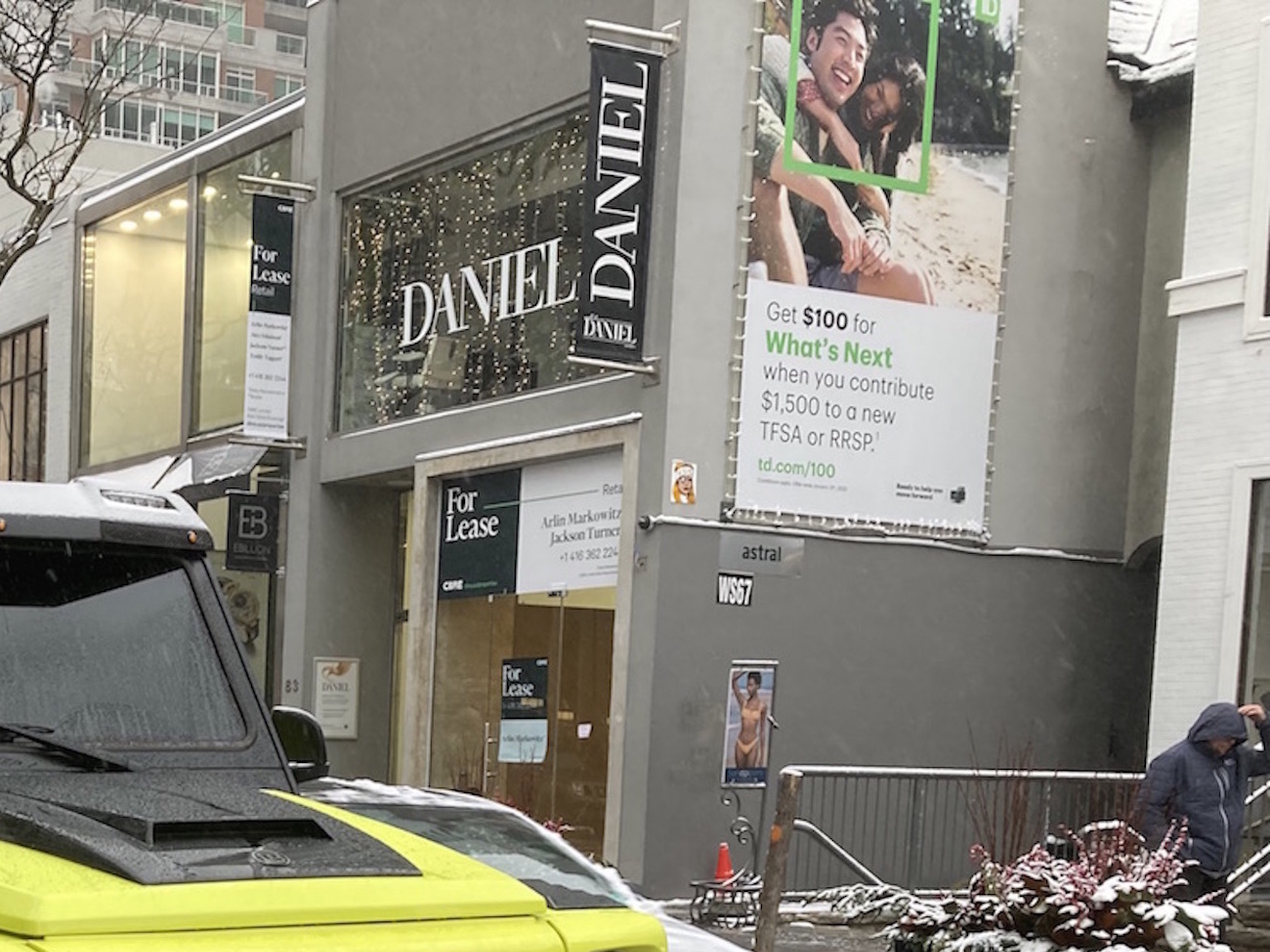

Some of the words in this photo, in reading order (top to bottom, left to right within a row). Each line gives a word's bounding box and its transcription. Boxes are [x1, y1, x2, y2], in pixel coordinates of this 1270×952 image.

[589, 61, 648, 308] DANIEL
[253, 244, 279, 263] For
[252, 264, 292, 285] Lease
[398, 237, 576, 347] DANIEL
[767, 301, 797, 324] Get
[803, 305, 849, 330] $100
[853, 313, 877, 335] for
[766, 330, 839, 361] What's
[844, 341, 893, 368] Next
[763, 362, 809, 384] when
[815, 371, 844, 390] you
[849, 377, 935, 400] contribute
[761, 389, 820, 415] $1,500
[825, 401, 841, 418] to
[846, 405, 857, 421] a
[862, 407, 896, 424] new
[760, 421, 802, 444] TFSA
[807, 431, 825, 446] or
[758, 457, 836, 479] td.com/100
[446, 487, 478, 515] For
[445, 515, 499, 542] Lease
[541, 514, 566, 529] Arlin
[550, 529, 586, 547] Jackson
[742, 544, 781, 562] astral
[718, 575, 753, 605] WS67
[502, 664, 523, 681] For
[502, 682, 534, 697] Lease
